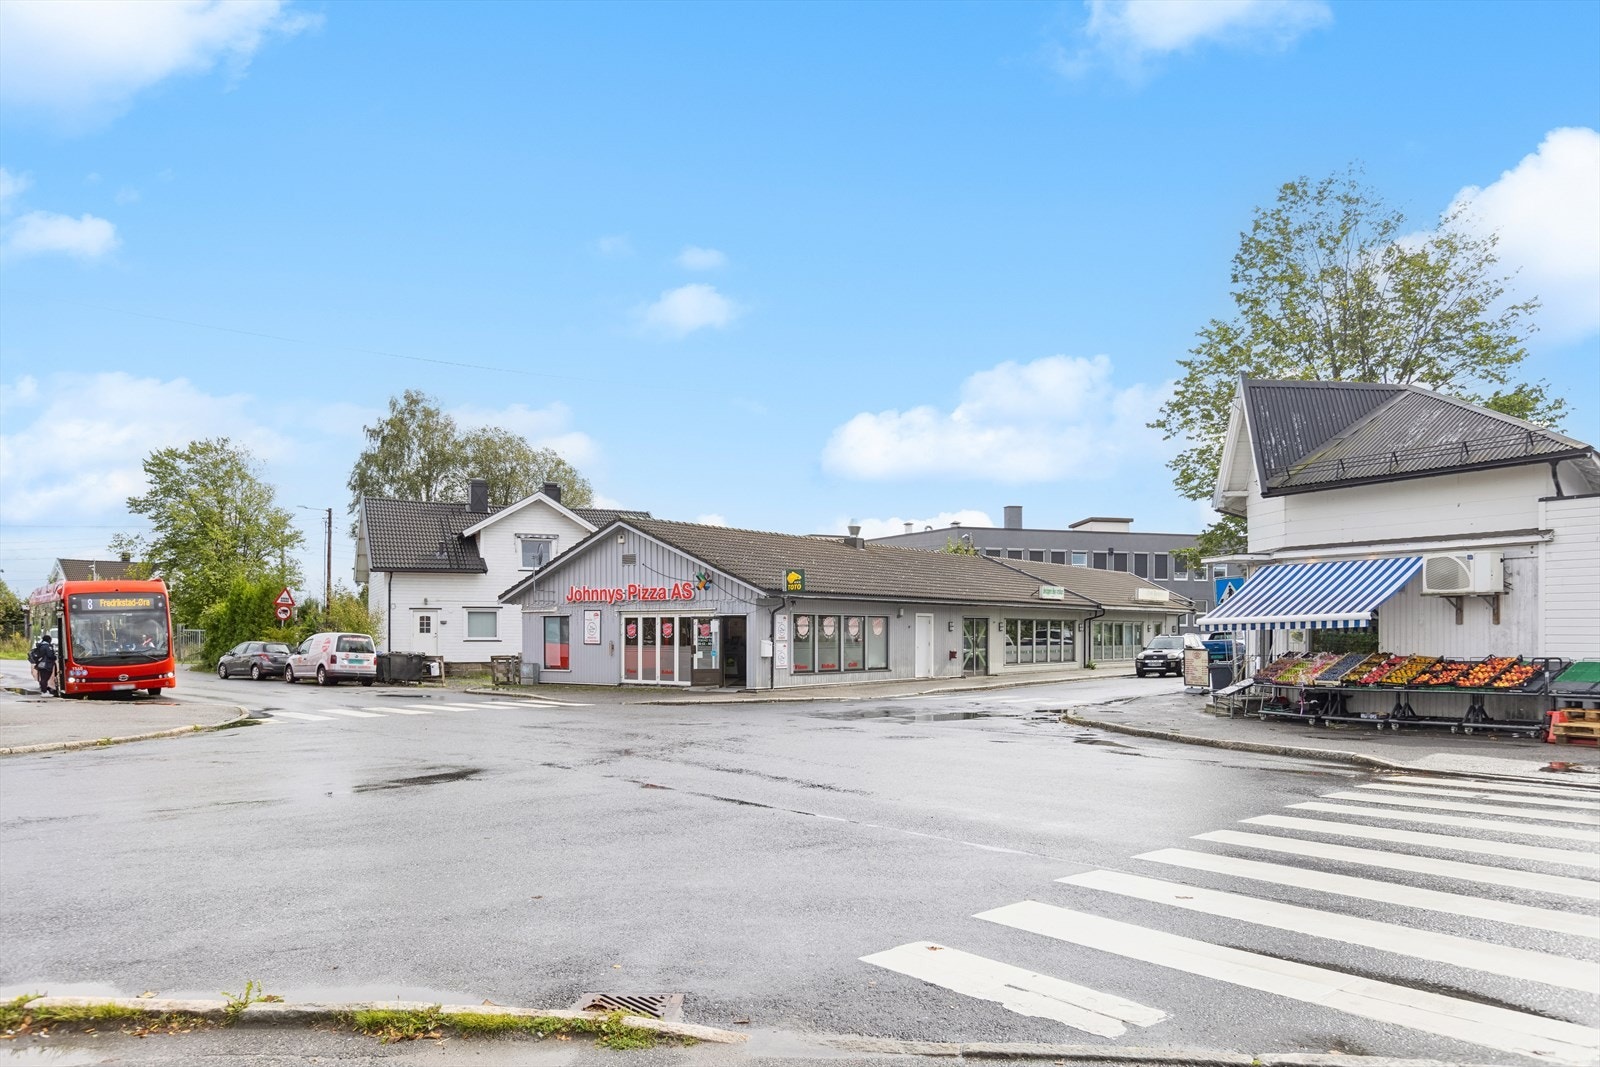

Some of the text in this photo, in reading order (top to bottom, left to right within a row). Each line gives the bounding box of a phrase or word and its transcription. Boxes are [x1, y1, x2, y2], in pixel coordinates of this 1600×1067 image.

[566, 582, 694, 604] Johnnys Pizza AS
[88, 598, 92, 610] 8
